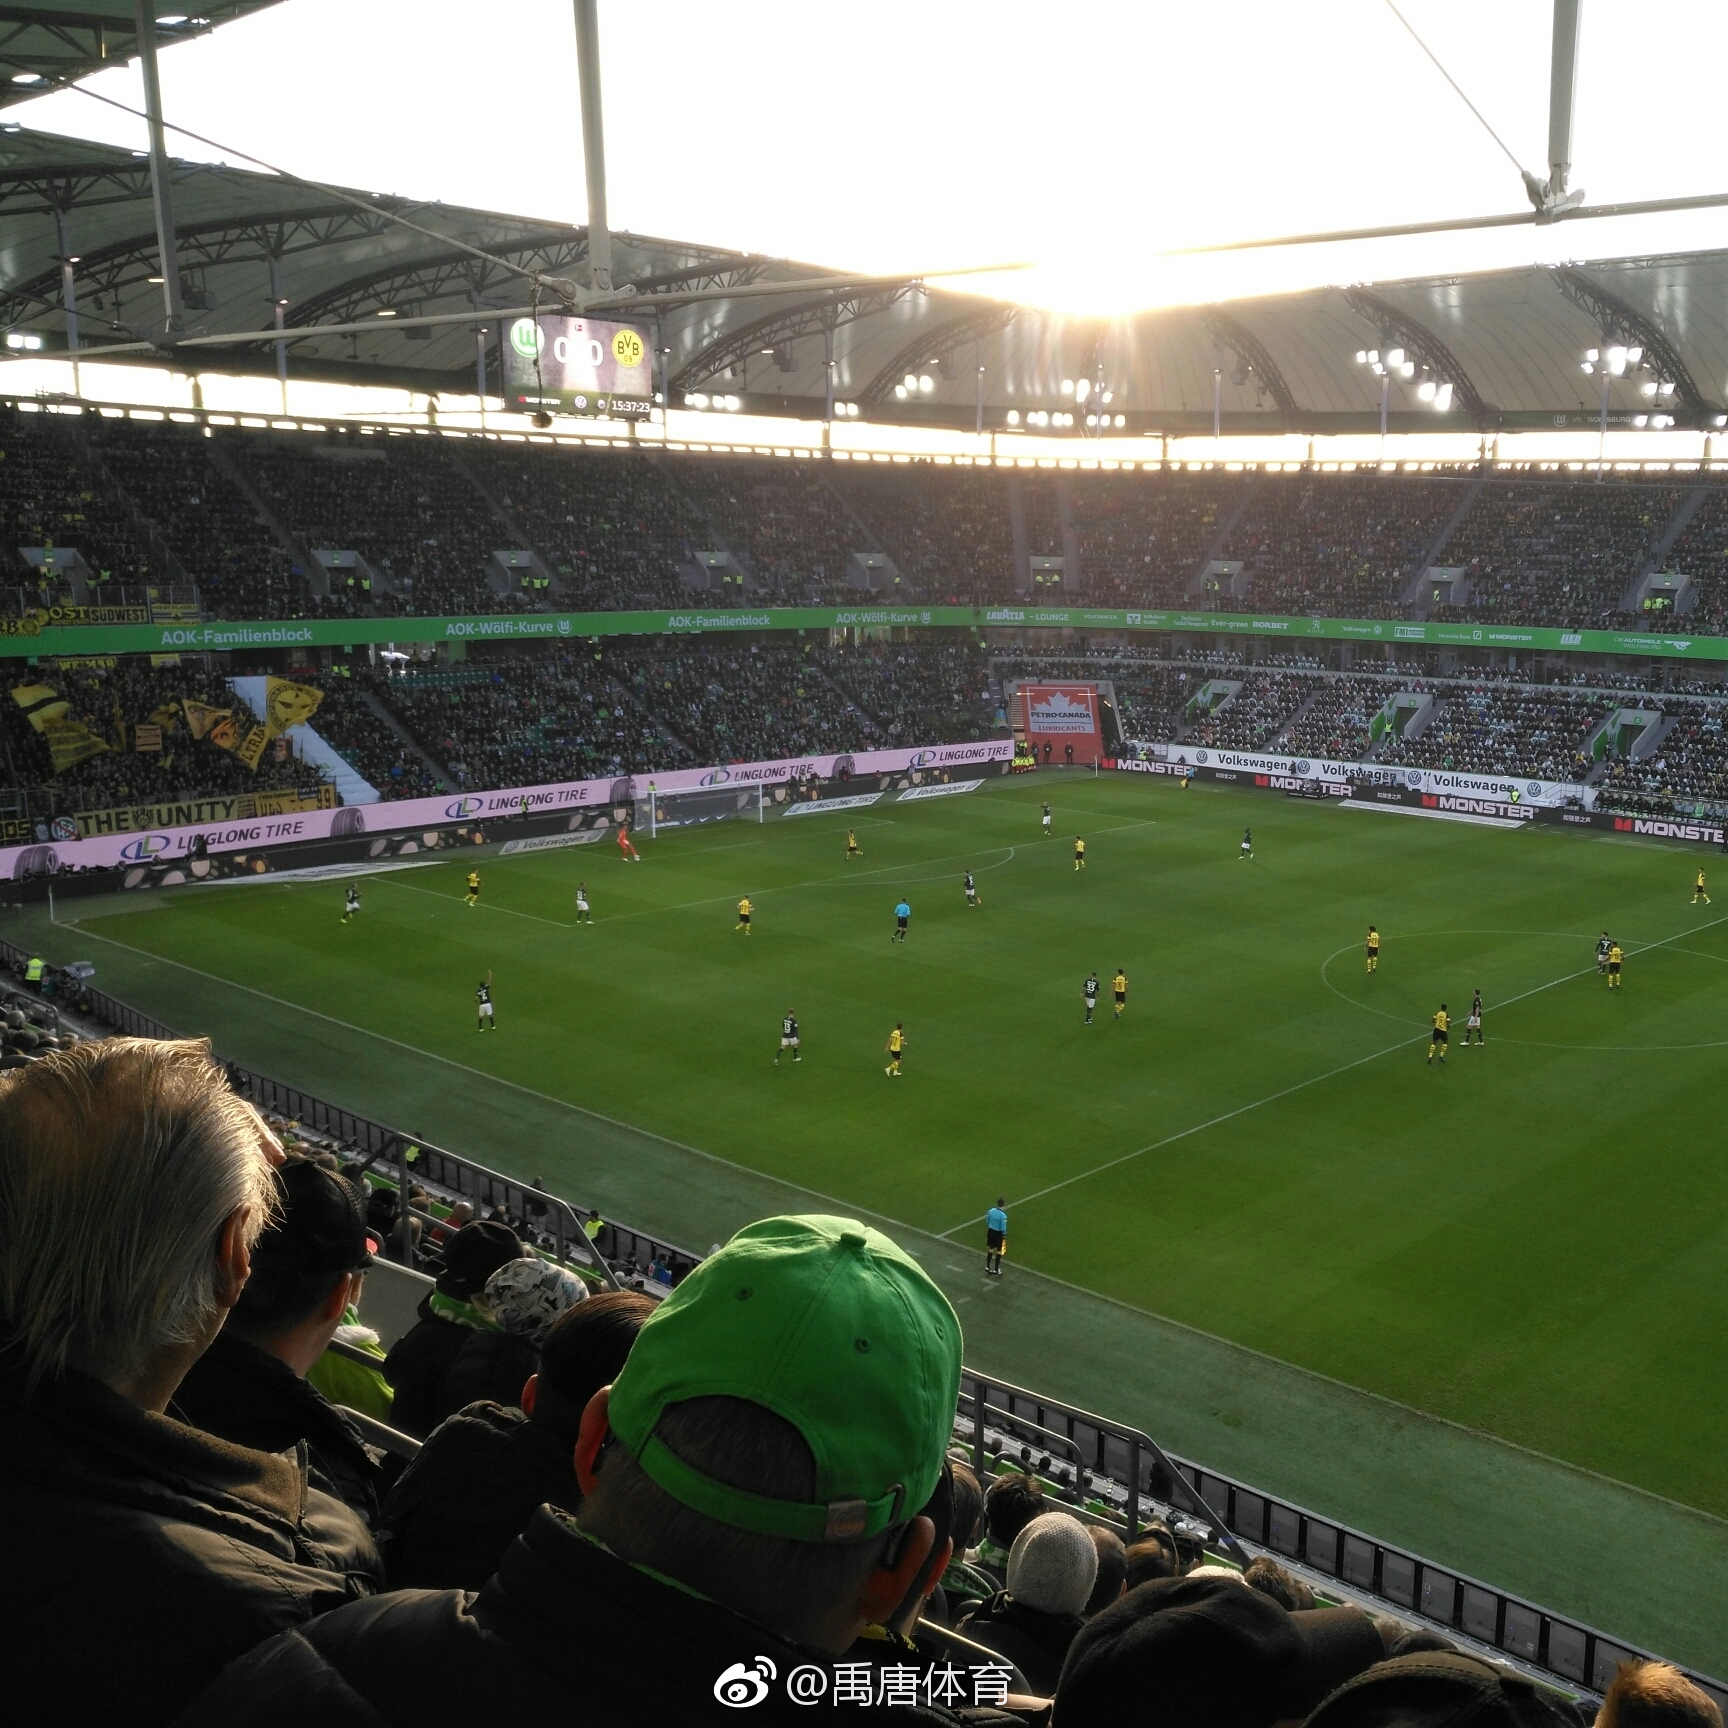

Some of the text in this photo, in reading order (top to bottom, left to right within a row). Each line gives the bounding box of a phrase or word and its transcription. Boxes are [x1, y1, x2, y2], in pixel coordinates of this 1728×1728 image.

[612, 402, 651, 412] 15:37:23
[49, 607, 87, 619] OST
[668, 614, 771, 628] AOK-Familienblock
[836, 612, 918, 624] AOK-Wölfi-Kurve
[986, 608, 1025, 621] LAVAZZA
[1036, 613, 1069, 622] LOUNGE
[446, 620, 553, 636] AOK-Wölfi-Kurve
[1211, 619, 1248, 629] Ever-green
[1252, 621, 1289, 630] BORBET
[1343, 626, 1372, 634] Volkswagen
[161, 628, 313, 645] AOK-Familienblock
[939, 748, 985, 762] LINGLONG
[987, 746, 1009, 759] TIRE
[1217, 753, 1287, 773] Volkswagen
[1434, 774, 1515, 795] Volkswagen
[558, 788, 588, 803] TIRE
[1439, 796, 1534, 820] MONSTER
[76, 810, 130, 835] THE
[156, 798, 236, 828] UNITY
[266, 821, 304, 839] TIRE
[1634, 819, 1727, 844] MONSTE
[522, 834, 584, 850] Volkswagen
